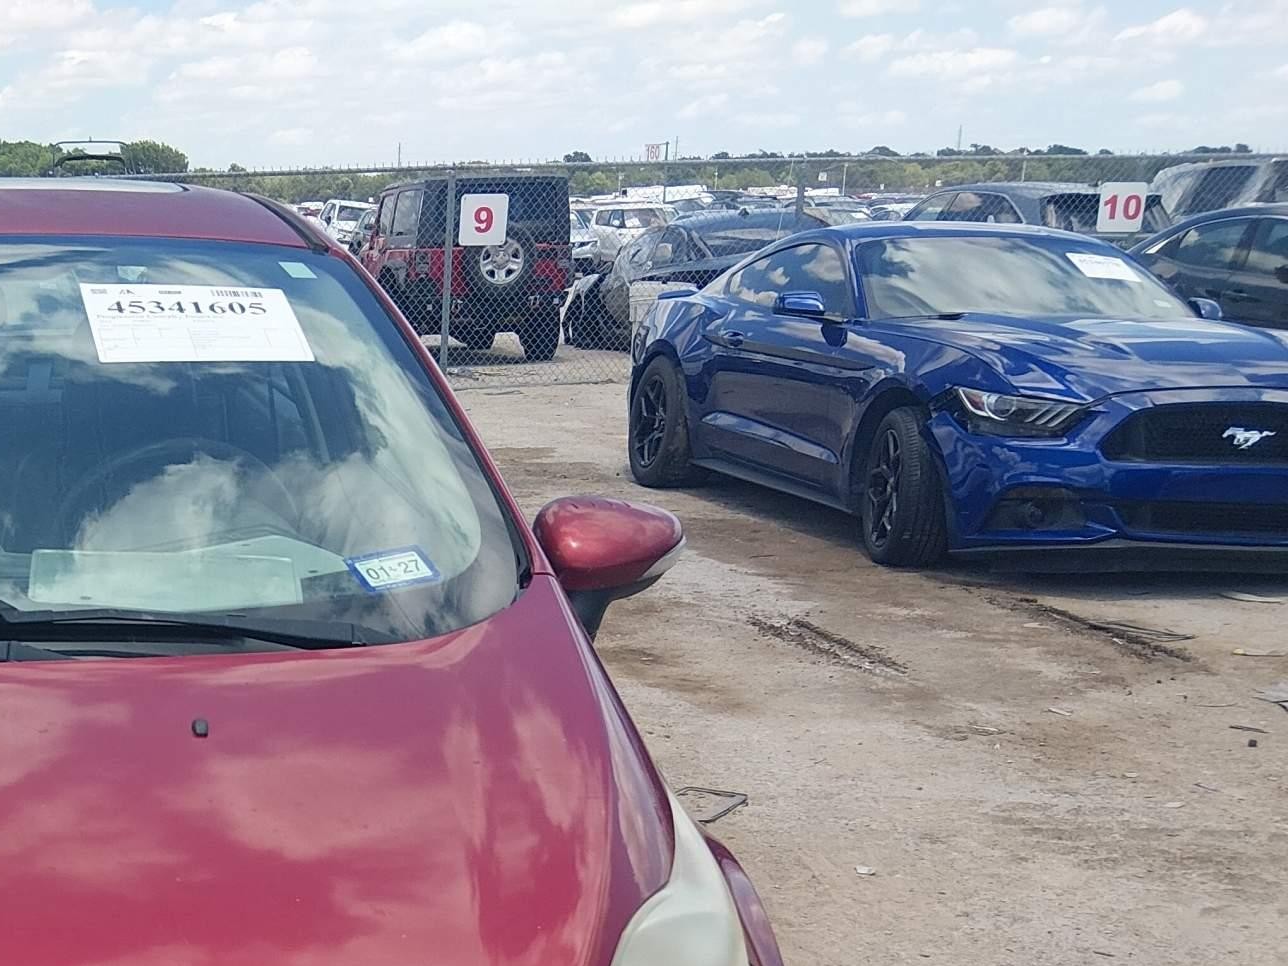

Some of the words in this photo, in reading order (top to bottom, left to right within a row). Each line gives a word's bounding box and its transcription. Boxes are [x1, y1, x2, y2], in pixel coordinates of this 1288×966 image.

[474, 206, 494, 233] 9
[1103, 194, 1142, 220] 10
[107, 300, 267, 316] 45341605
